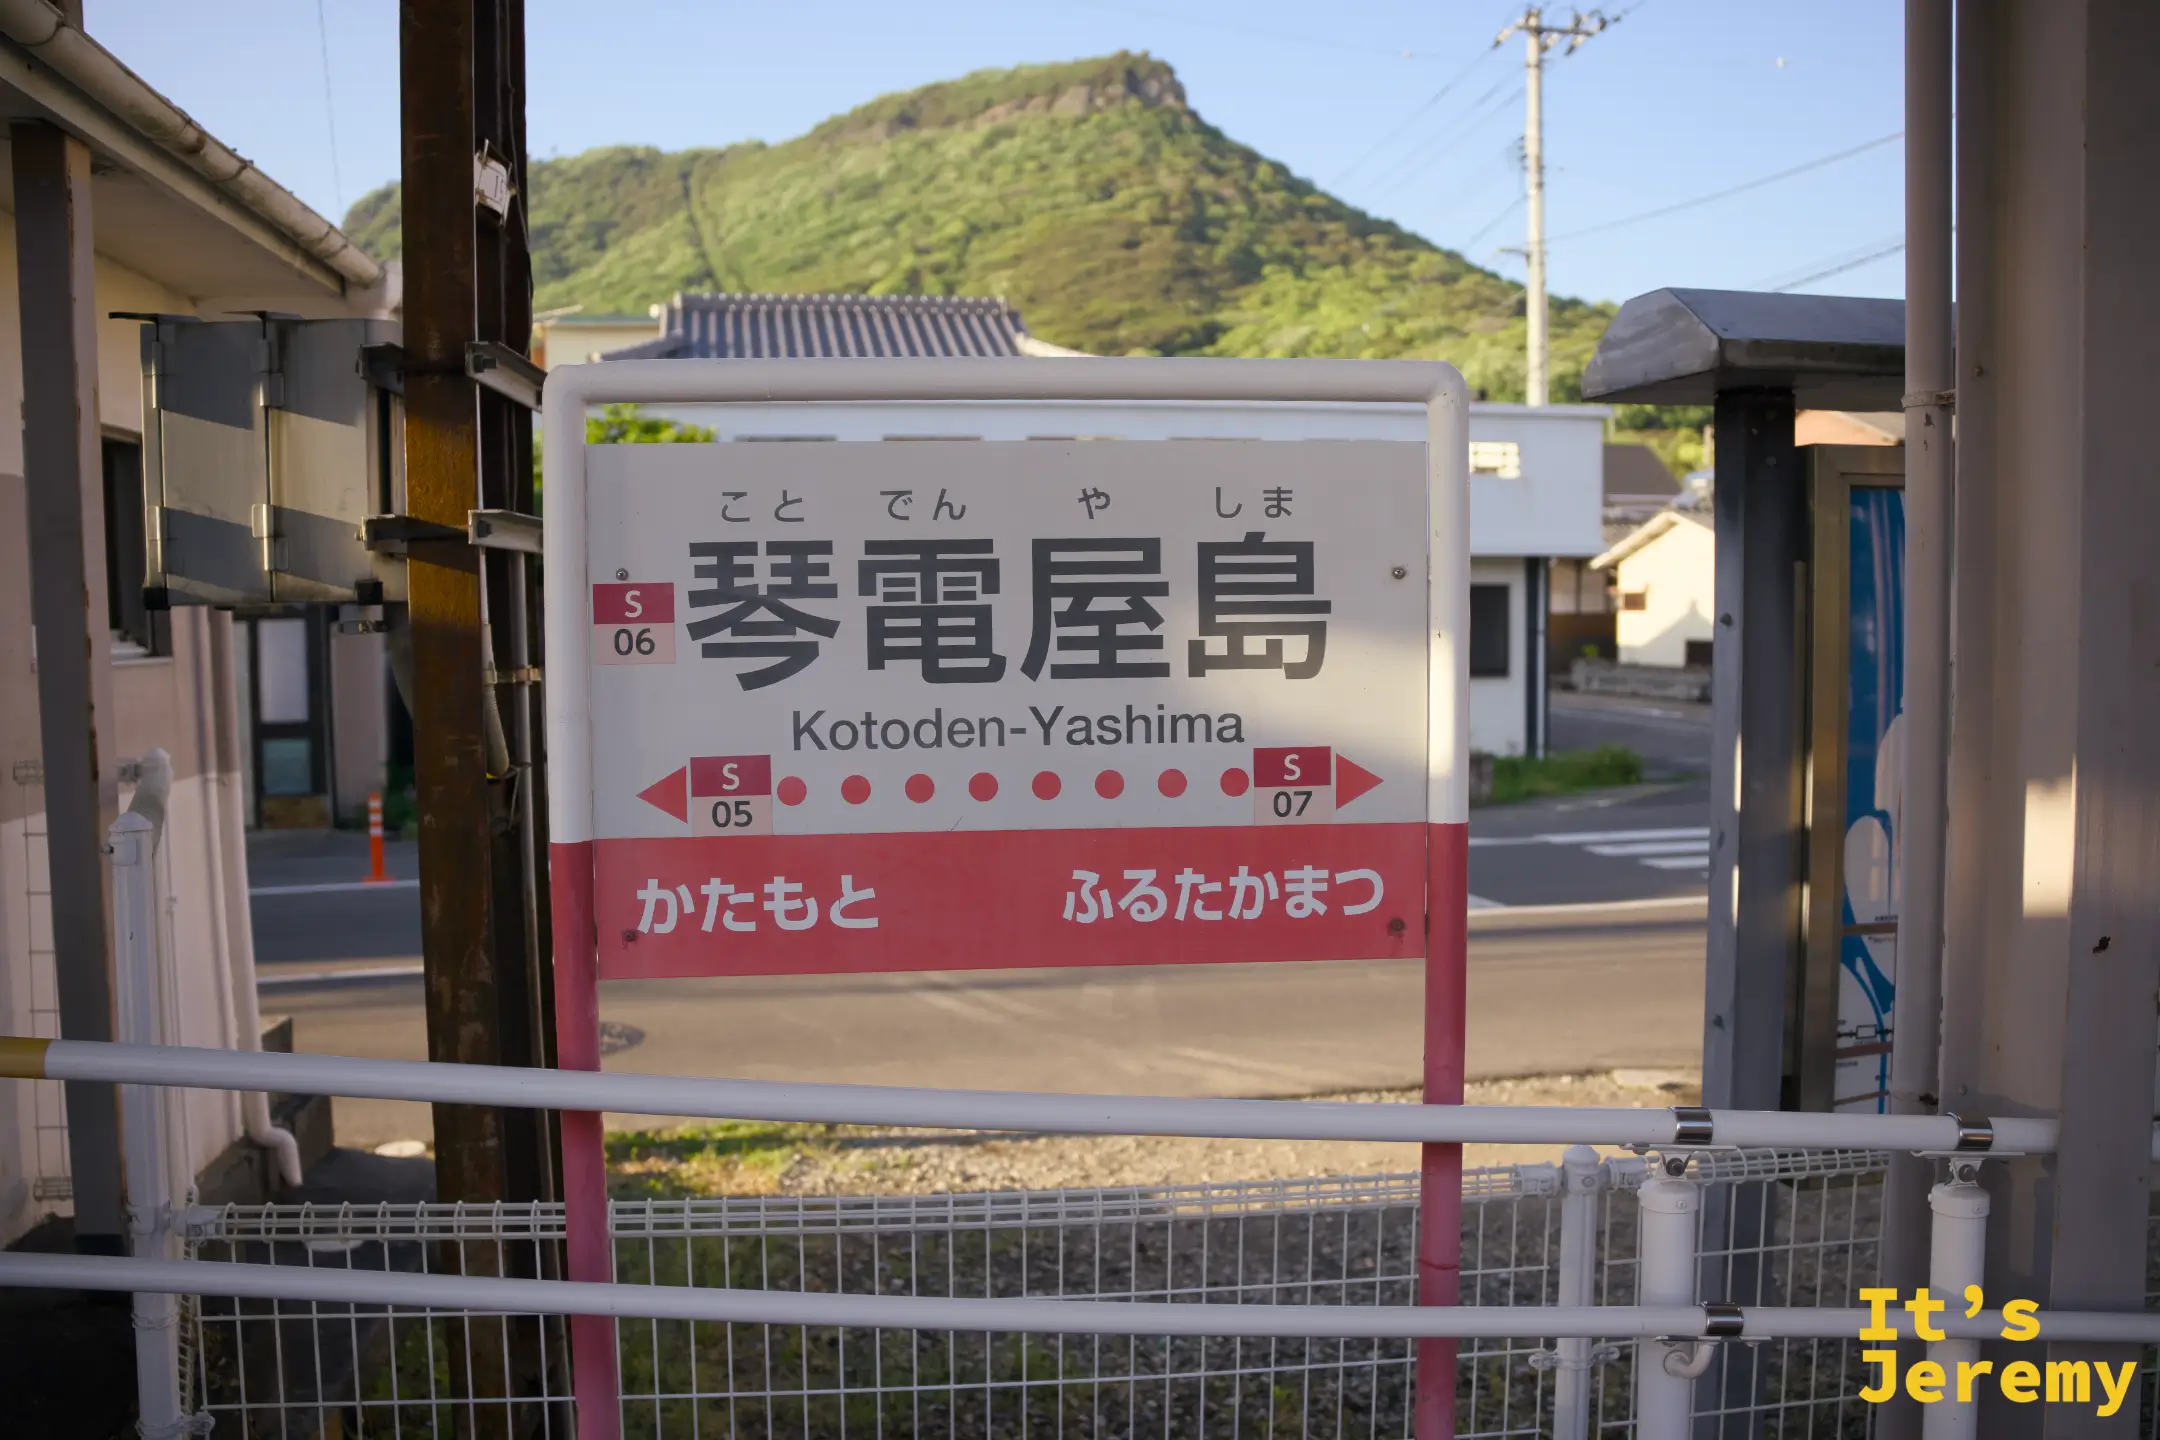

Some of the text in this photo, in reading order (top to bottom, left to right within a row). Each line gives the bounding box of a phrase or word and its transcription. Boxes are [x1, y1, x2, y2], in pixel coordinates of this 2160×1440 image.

[624, 589, 643, 618] S
[685, 531, 1332, 692] 琴電屋島
[613, 627, 656, 657] 06
[792, 703, 1245, 751] Kotoden-Yashima
[722, 762, 740, 791] S
[1283, 753, 1301, 781] S
[711, 800, 753, 828] 05
[1273, 790, 1313, 818] 07
[636, 874, 879, 935] かたもと
[1062, 864, 1385, 924] ふるたかまつ
